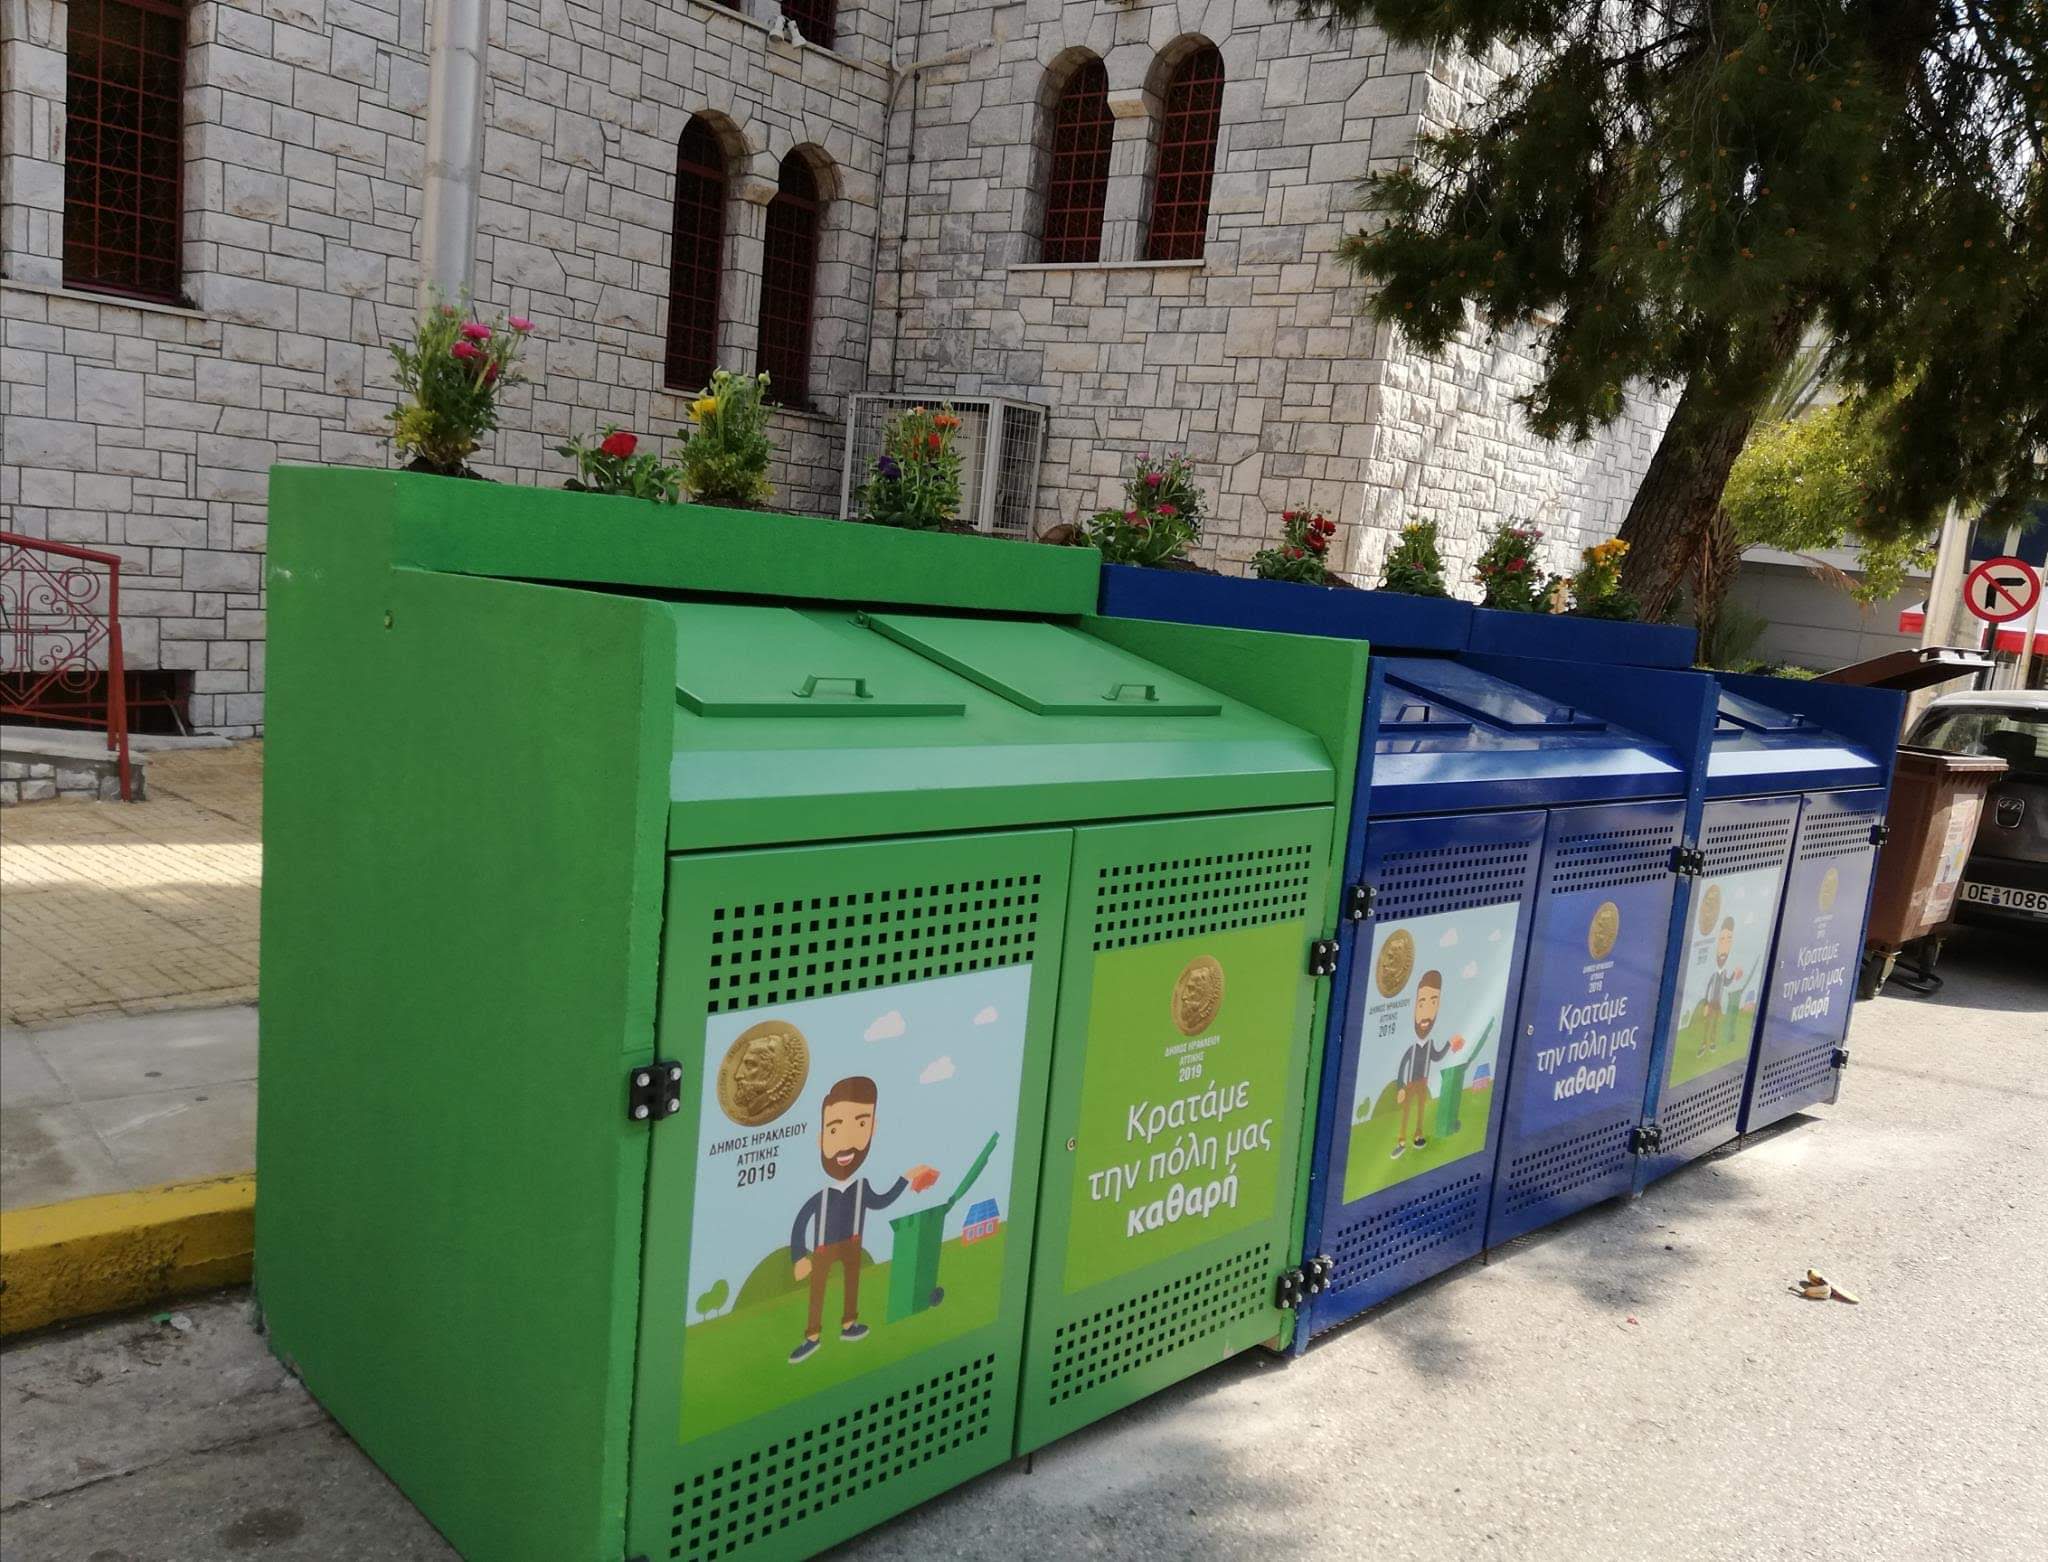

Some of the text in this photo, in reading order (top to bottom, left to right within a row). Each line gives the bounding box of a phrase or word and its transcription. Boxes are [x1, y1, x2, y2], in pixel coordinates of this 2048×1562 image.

[1797, 938, 1840, 970] Κρατάμε
[1784, 966, 1846, 1000] την πόλη μας
[1559, 993, 1628, 1034] Κρατάμε
[1790, 990, 1830, 1023] καθαρή
[1536, 1026, 1640, 1074] την πόλη μας
[1178, 1064, 1202, 1082] 2019
[1554, 1056, 1617, 1101] καθαρή
[1126, 1079, 1250, 1144] Κρατάμε
[709, 1122, 808, 1157] ΔΗΜΟΣ ΗΡΑΚΛΕΙΟΥ
[736, 1145, 780, 1167] ΑΤΤΙΚΗΣ
[737, 1162, 777, 1188] 2019
[1088, 1118, 1273, 1203] την πόλη μας
[1126, 1164, 1239, 1238] καθαρή
